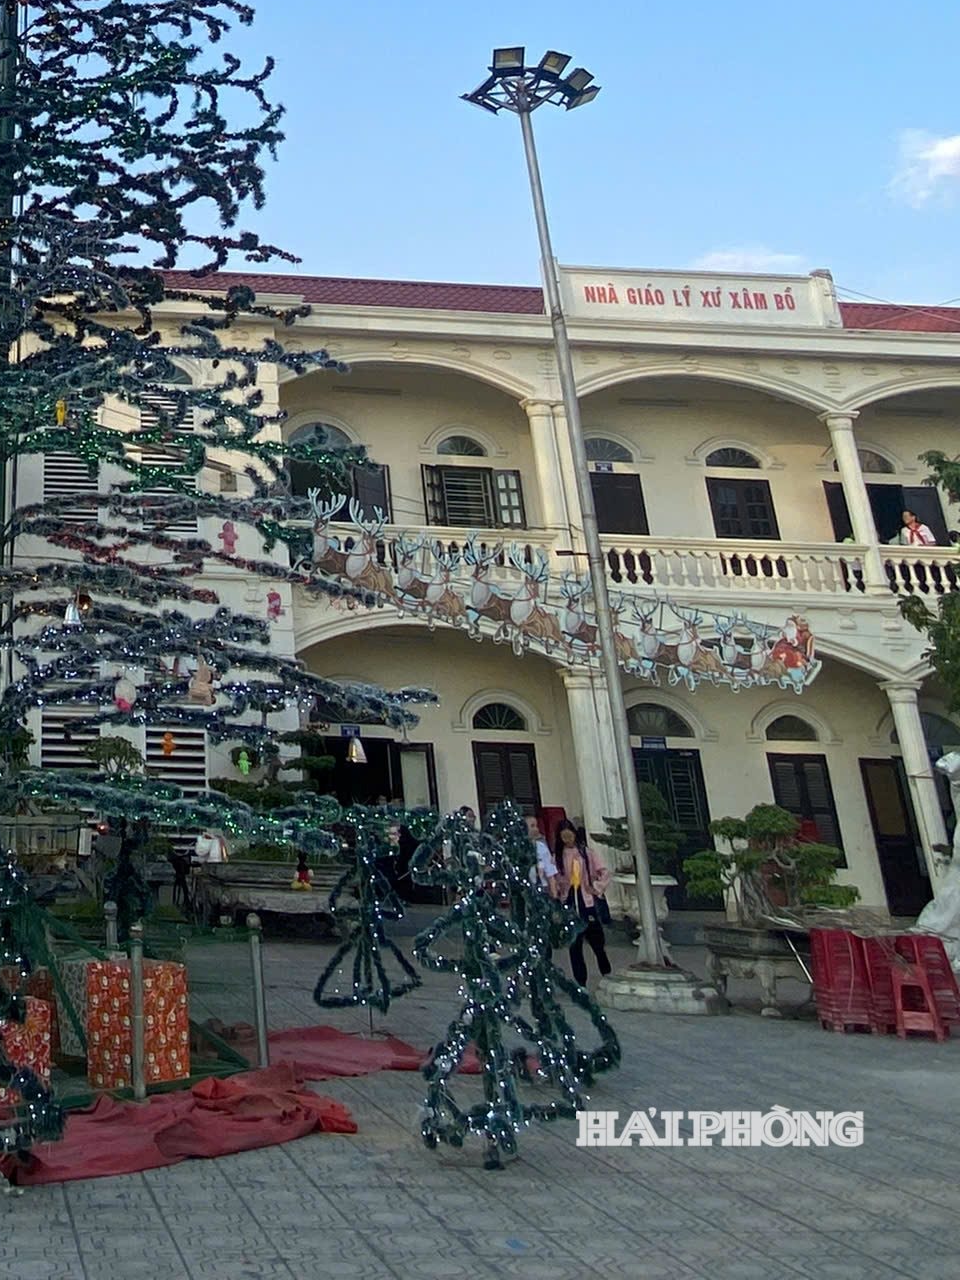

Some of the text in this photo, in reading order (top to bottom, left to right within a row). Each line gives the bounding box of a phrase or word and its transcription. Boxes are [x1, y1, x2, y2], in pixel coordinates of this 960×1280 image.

[584, 283, 619, 304] NHÀ
[626, 283, 665, 306] GIÁO
[672, 284, 690, 307] LÝ
[728, 287, 768, 310] XÂM
